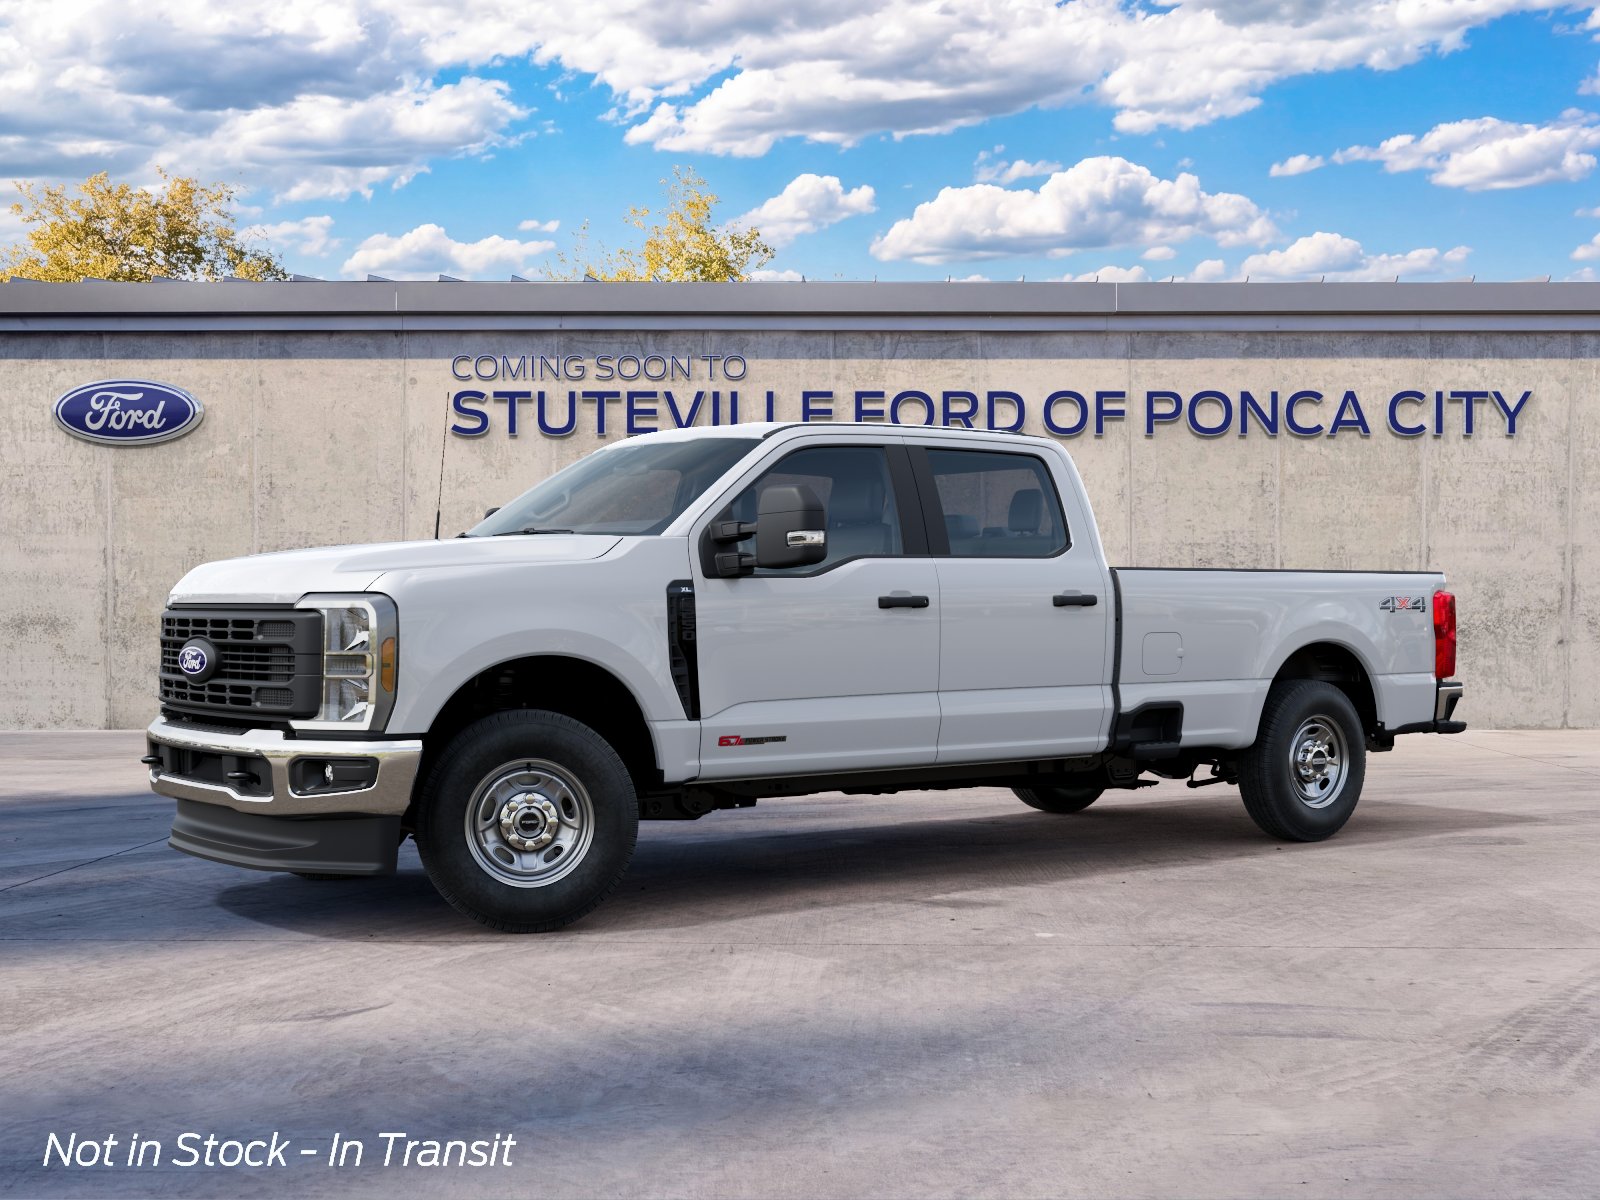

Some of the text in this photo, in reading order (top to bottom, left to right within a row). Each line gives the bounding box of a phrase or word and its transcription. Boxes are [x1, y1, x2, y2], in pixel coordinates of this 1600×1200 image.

[452, 355, 748, 381] COMING SOON TO
[85, 391, 167, 431] Ford
[854, 390, 1026, 433] FORD
[1042, 390, 1127, 437] OF
[1145, 390, 1372, 437] PONCA
[1387, 390, 1533, 437] CITY
[183, 650, 202, 670] Ford
